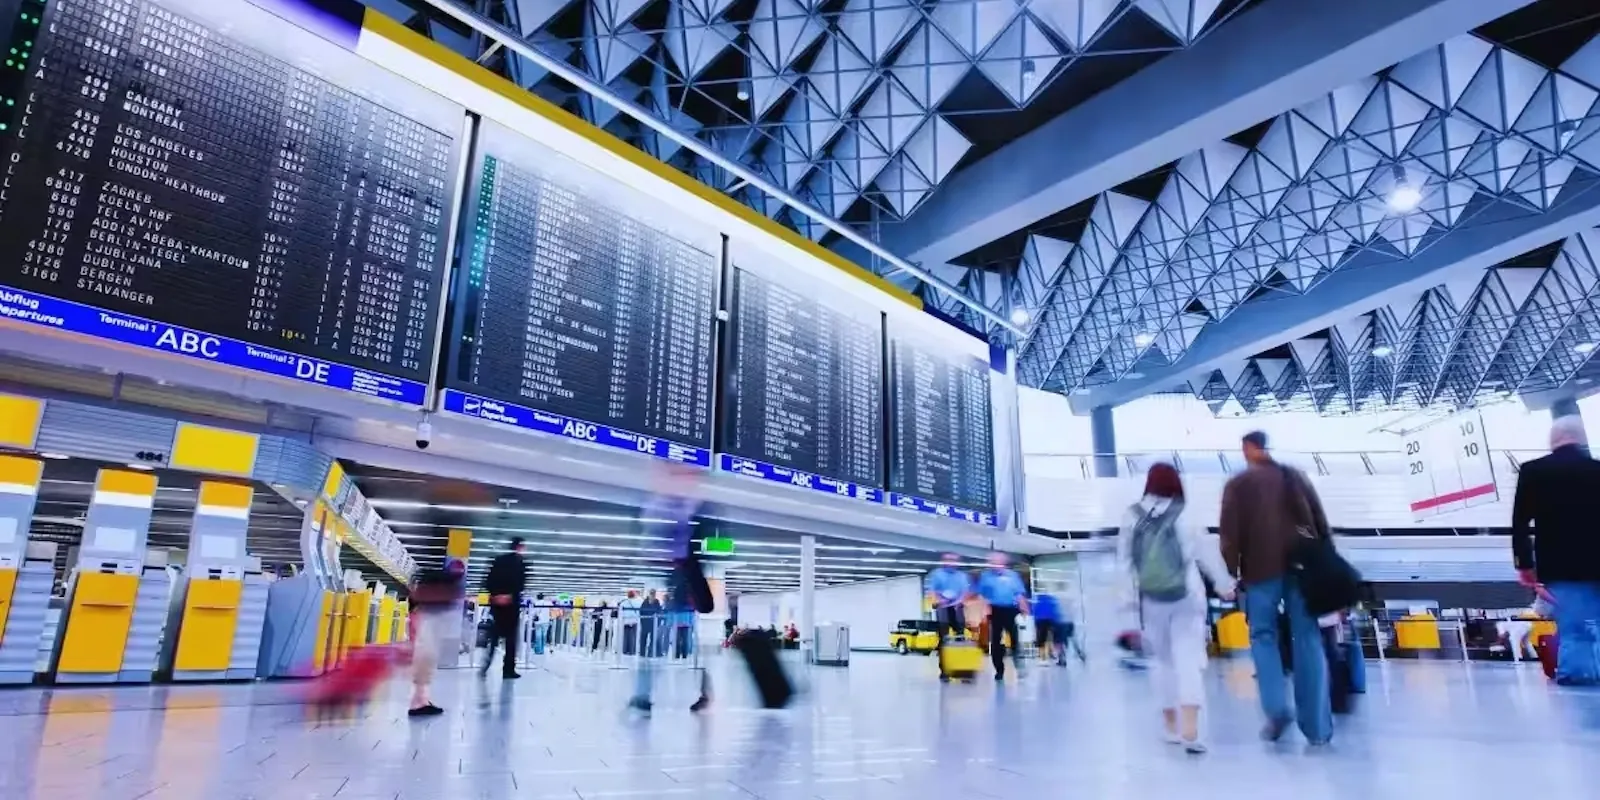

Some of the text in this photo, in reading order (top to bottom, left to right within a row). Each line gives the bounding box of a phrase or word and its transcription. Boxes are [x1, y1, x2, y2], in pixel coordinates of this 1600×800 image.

[140, 36, 178, 58] MIAMI
[145, 15, 205, 47] HELSINKI
[80, 84, 106, 102] 875
[122, 100, 186, 131] MONTREAL
[84, 74, 109, 90] 494
[125, 90, 181, 118] CALGARY
[67, 131, 94, 147] 440
[110, 145, 168, 173] HOUSTON
[70, 119, 97, 136] 442
[113, 134, 170, 161] DETROIT
[74, 107, 100, 124] 456
[116, 122, 141, 139] LOS
[149, 134, 204, 161] ANGELES
[55, 140, 90, 160] 4726
[107, 157, 225, 204] LONDON-HEATHROW
[57, 167, 84, 183] 417
[101, 180, 152, 204] ZAGREB
[45, 176, 81, 195] 6808
[98, 192, 141, 213] KOELN
[148, 207, 173, 223] HBF
[47, 203, 75, 219] 590
[91, 216, 135, 236] ADDIS
[142, 231, 249, 269] ABEBA-KHARTOUM
[95, 205, 120, 220] TEL
[129, 215, 162, 232] AVIV
[27, 239, 64, 257] 4980
[81, 253, 135, 275] DUBLIN
[41, 229, 67, 243] 117
[85, 241, 162, 269] LJUBLJANA
[45, 216, 71, 231] 176
[88, 228, 187, 264] BERLIN-TEGEL
[20, 264, 58, 282] 3160
[75, 278, 154, 305] STAVANGER
[23, 251, 61, 269] 3126
[78, 265, 132, 287] BERGEN
[0, 290, 39, 309] Abflug
[0, 304, 64, 325] epartures
[100, 313, 330, 383] Terminal 1 ABC Terminal 2 DE
[523, 360, 558, 376] HELSINKI
[562, 421, 597, 441] ABC
[637, 437, 656, 454] DE
[1460, 422, 1474, 436] 10
[1407, 441, 1420, 455] 20
[1464, 443, 1478, 457] 10
[791, 472, 813, 488] ABC
[837, 483, 849, 495] DE
[1410, 461, 1423, 475] 20
